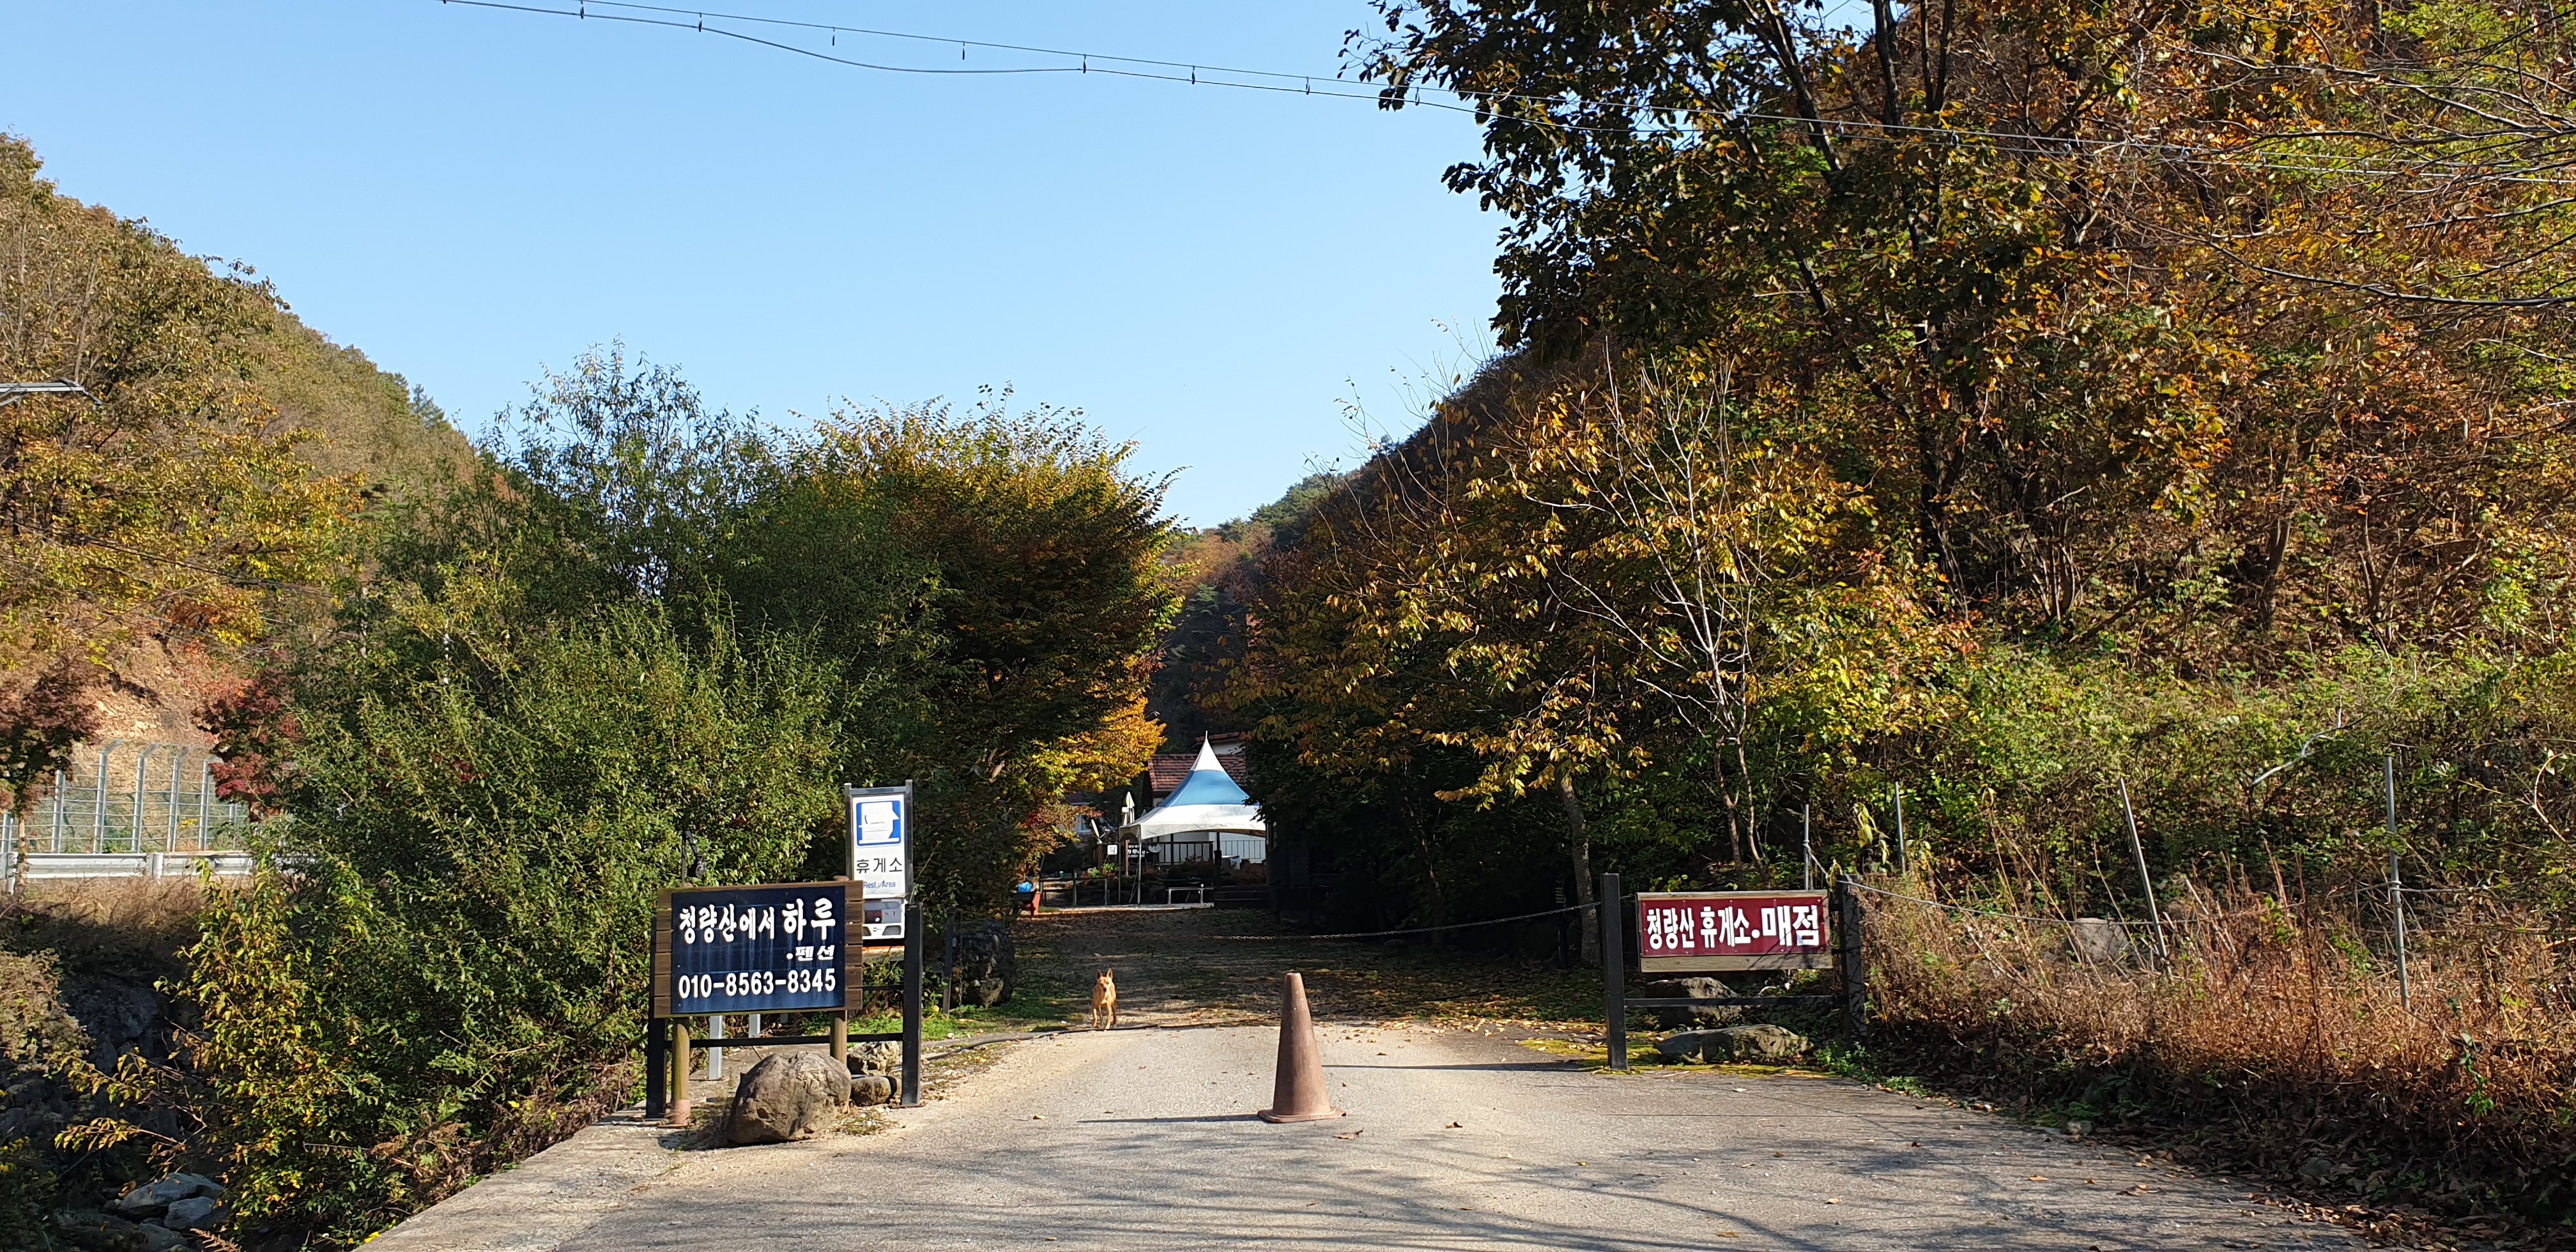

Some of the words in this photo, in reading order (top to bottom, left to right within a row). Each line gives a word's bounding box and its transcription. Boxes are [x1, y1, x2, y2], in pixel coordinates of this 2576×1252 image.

[856, 857, 903, 874] 휴게소
[679, 903, 775, 944] 청량산에서
[781, 897, 836, 940] 하루
[1646, 907, 1695, 950] 청량산
[678, 968, 836, 999] 010-8563-8345
